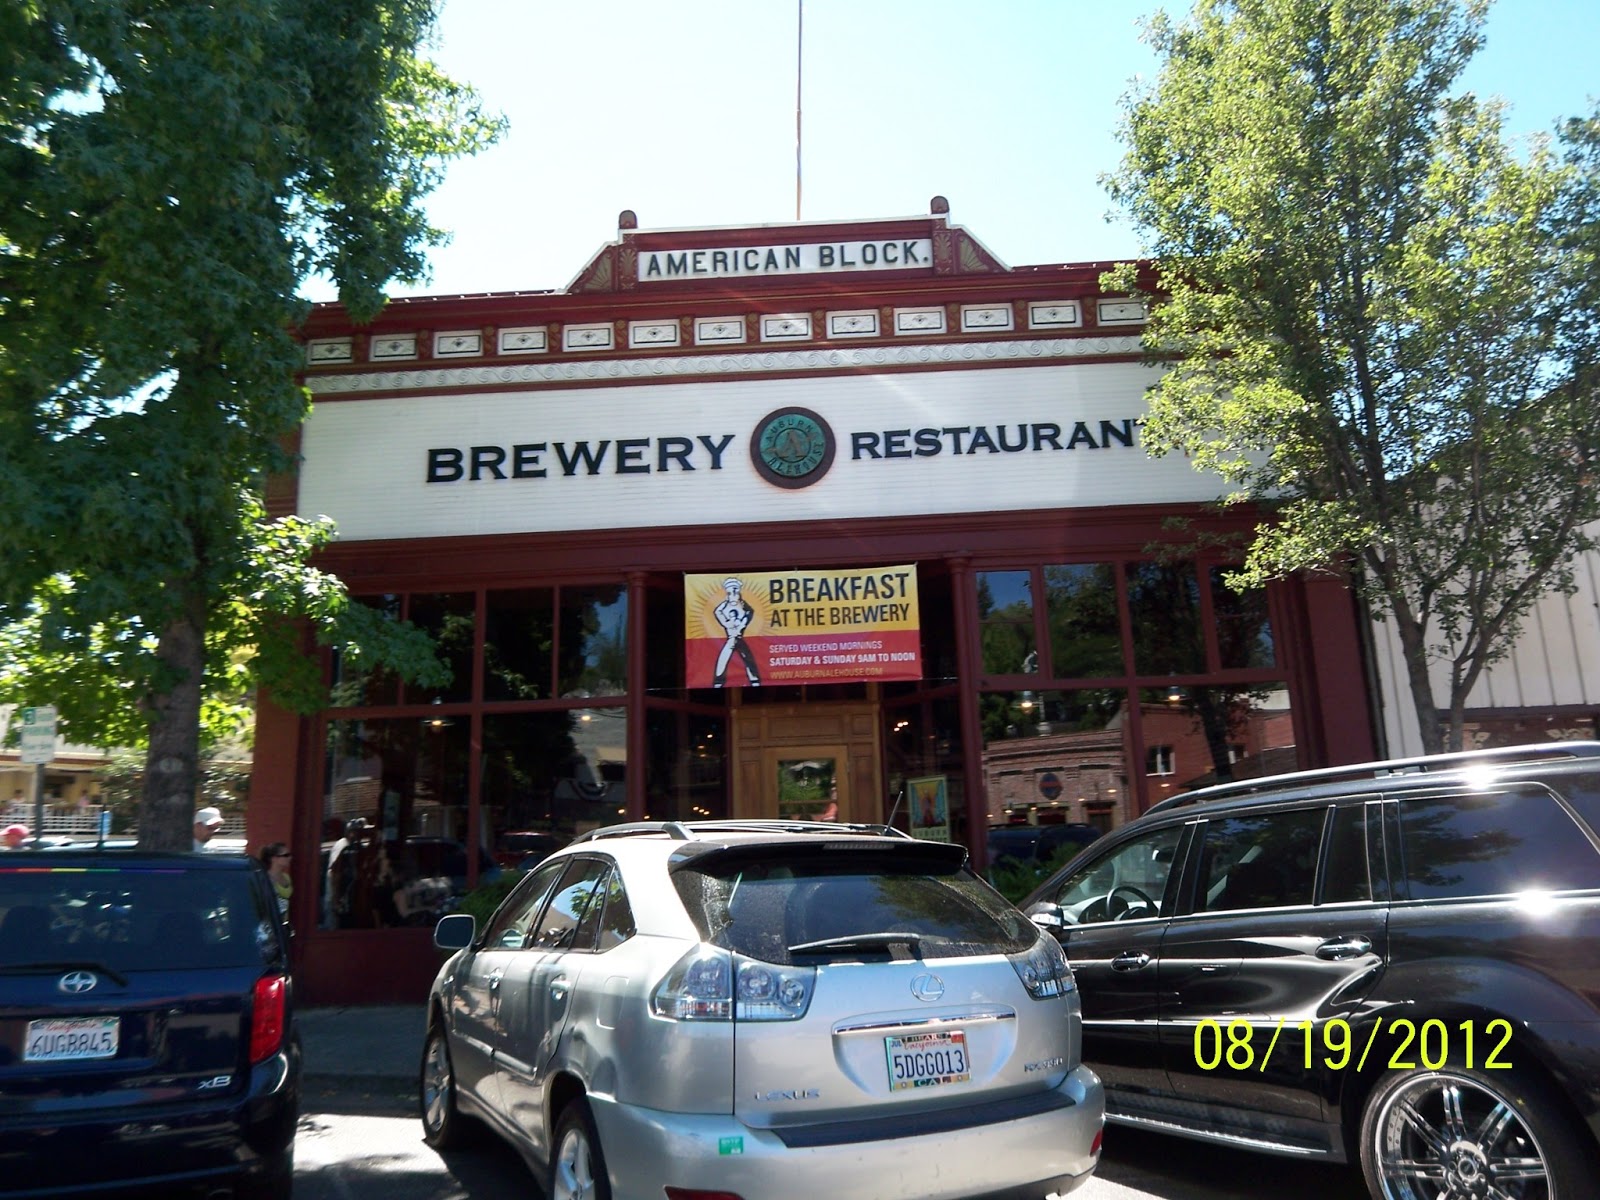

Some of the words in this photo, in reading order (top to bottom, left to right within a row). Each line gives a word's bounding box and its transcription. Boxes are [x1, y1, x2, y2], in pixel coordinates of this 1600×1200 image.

[647, 247, 801, 277] AMERICAN
[818, 240, 930, 267] BLOCK.
[765, 418, 814, 441] AUBURN
[850, 418, 1149, 460] RESTAURAN
[426, 434, 736, 483] BREWERY
[770, 573, 909, 604] BREAKFAST
[770, 610, 791, 627] AT
[794, 607, 826, 627] THE
[831, 604, 910, 625] BREWERY
[769, 644, 799, 654] SERVED
[800, 642, 838, 652] WEEKEND
[839, 640, 883, 651] MORNINGS
[769, 655, 812, 667] SATURDAY
[813, 655, 821, 665] &
[822, 654, 856, 665] SUNDAY
[857, 653, 876, 663] 9AM
[878, 653, 889, 662] TO
[890, 652, 916, 662] NOON
[770, 668, 883, 679] WWW.AUBURNALEHOUSE.COM
[30, 1031, 112, 1055] 6UGB845
[894, 1049, 965, 1080] 5DGG013
